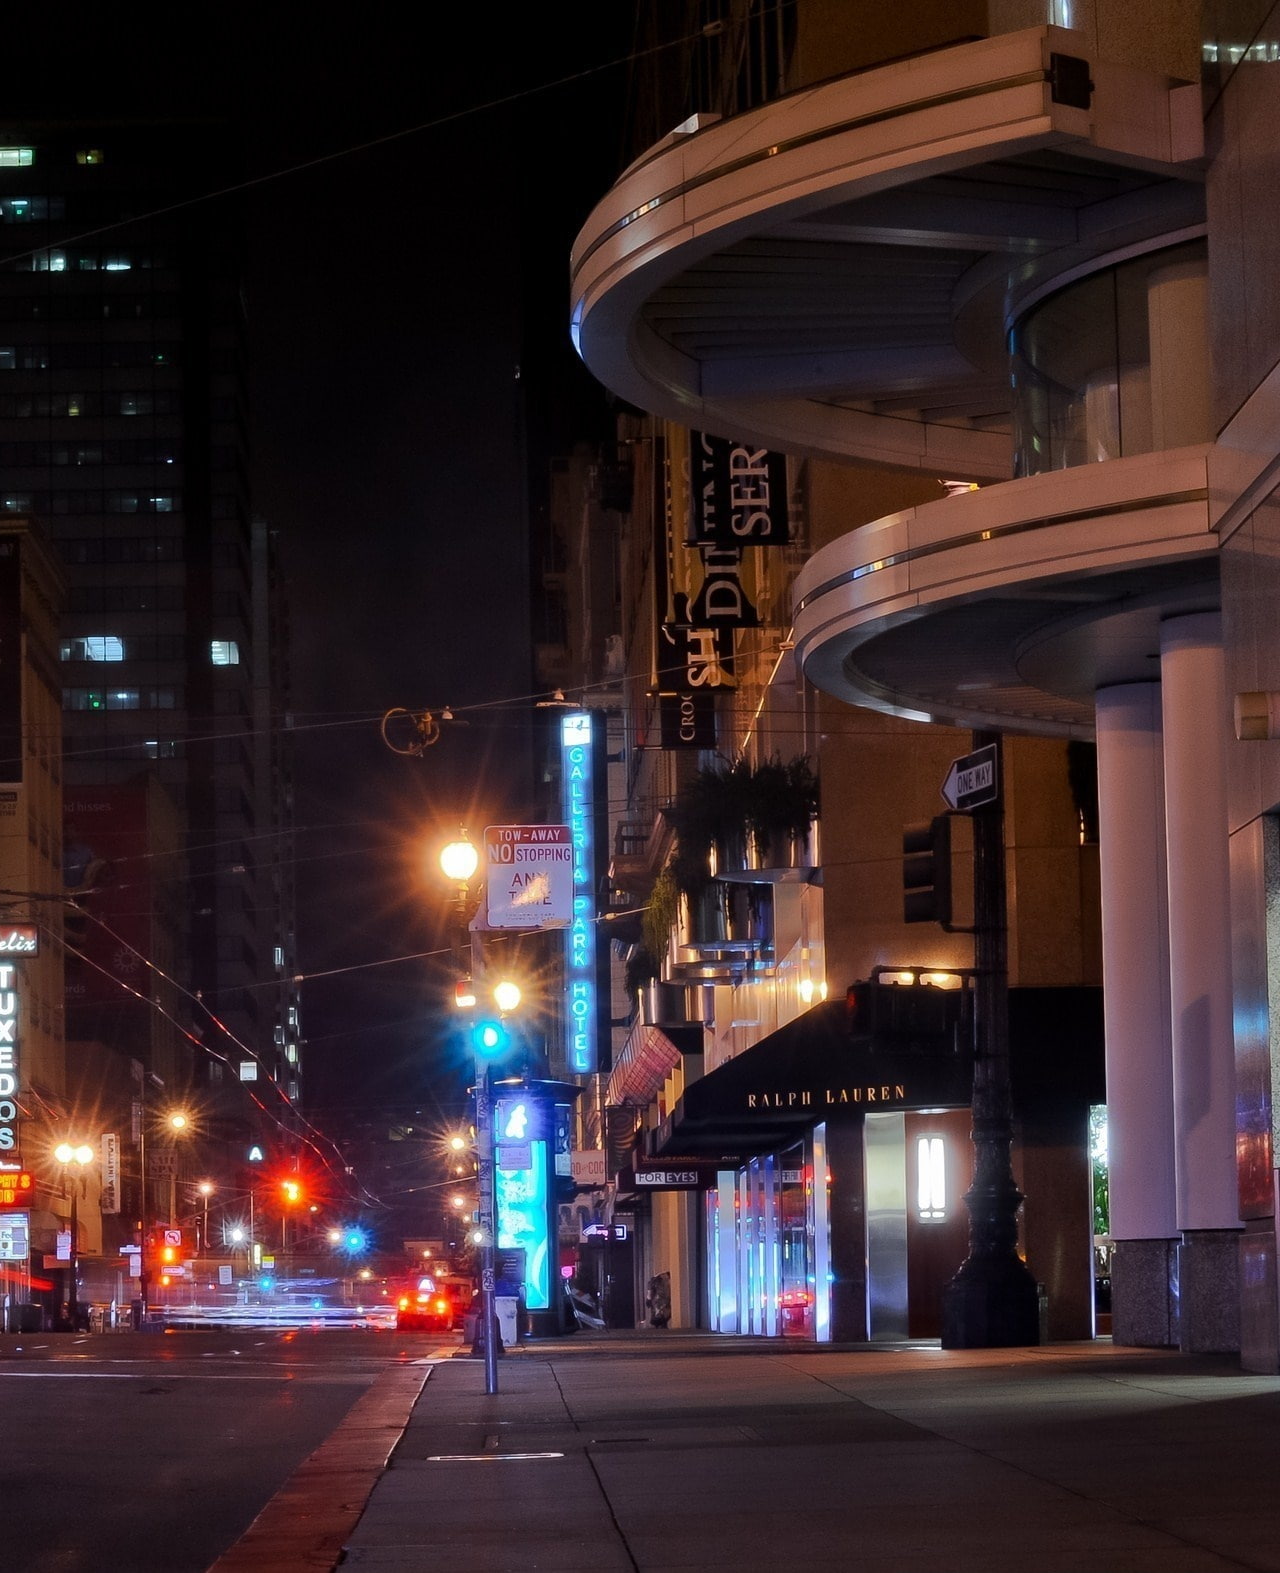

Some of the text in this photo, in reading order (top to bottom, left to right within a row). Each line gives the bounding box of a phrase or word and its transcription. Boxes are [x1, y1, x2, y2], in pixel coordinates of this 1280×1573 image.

[730, 441, 771, 536] SER
[957, 763, 991, 794] ONE WAY
[570, 747, 587, 883] GALLERIA
[498, 829, 561, 841] TOW-AWAY
[487, 843, 571, 863] NO STOPPING
[573, 898, 587, 966] PARK
[572, 982, 588, 1067] HOTEL
[748, 1085, 904, 1108] RALPH LAUREN
[638, 1172, 696, 1183] FOR EYES
